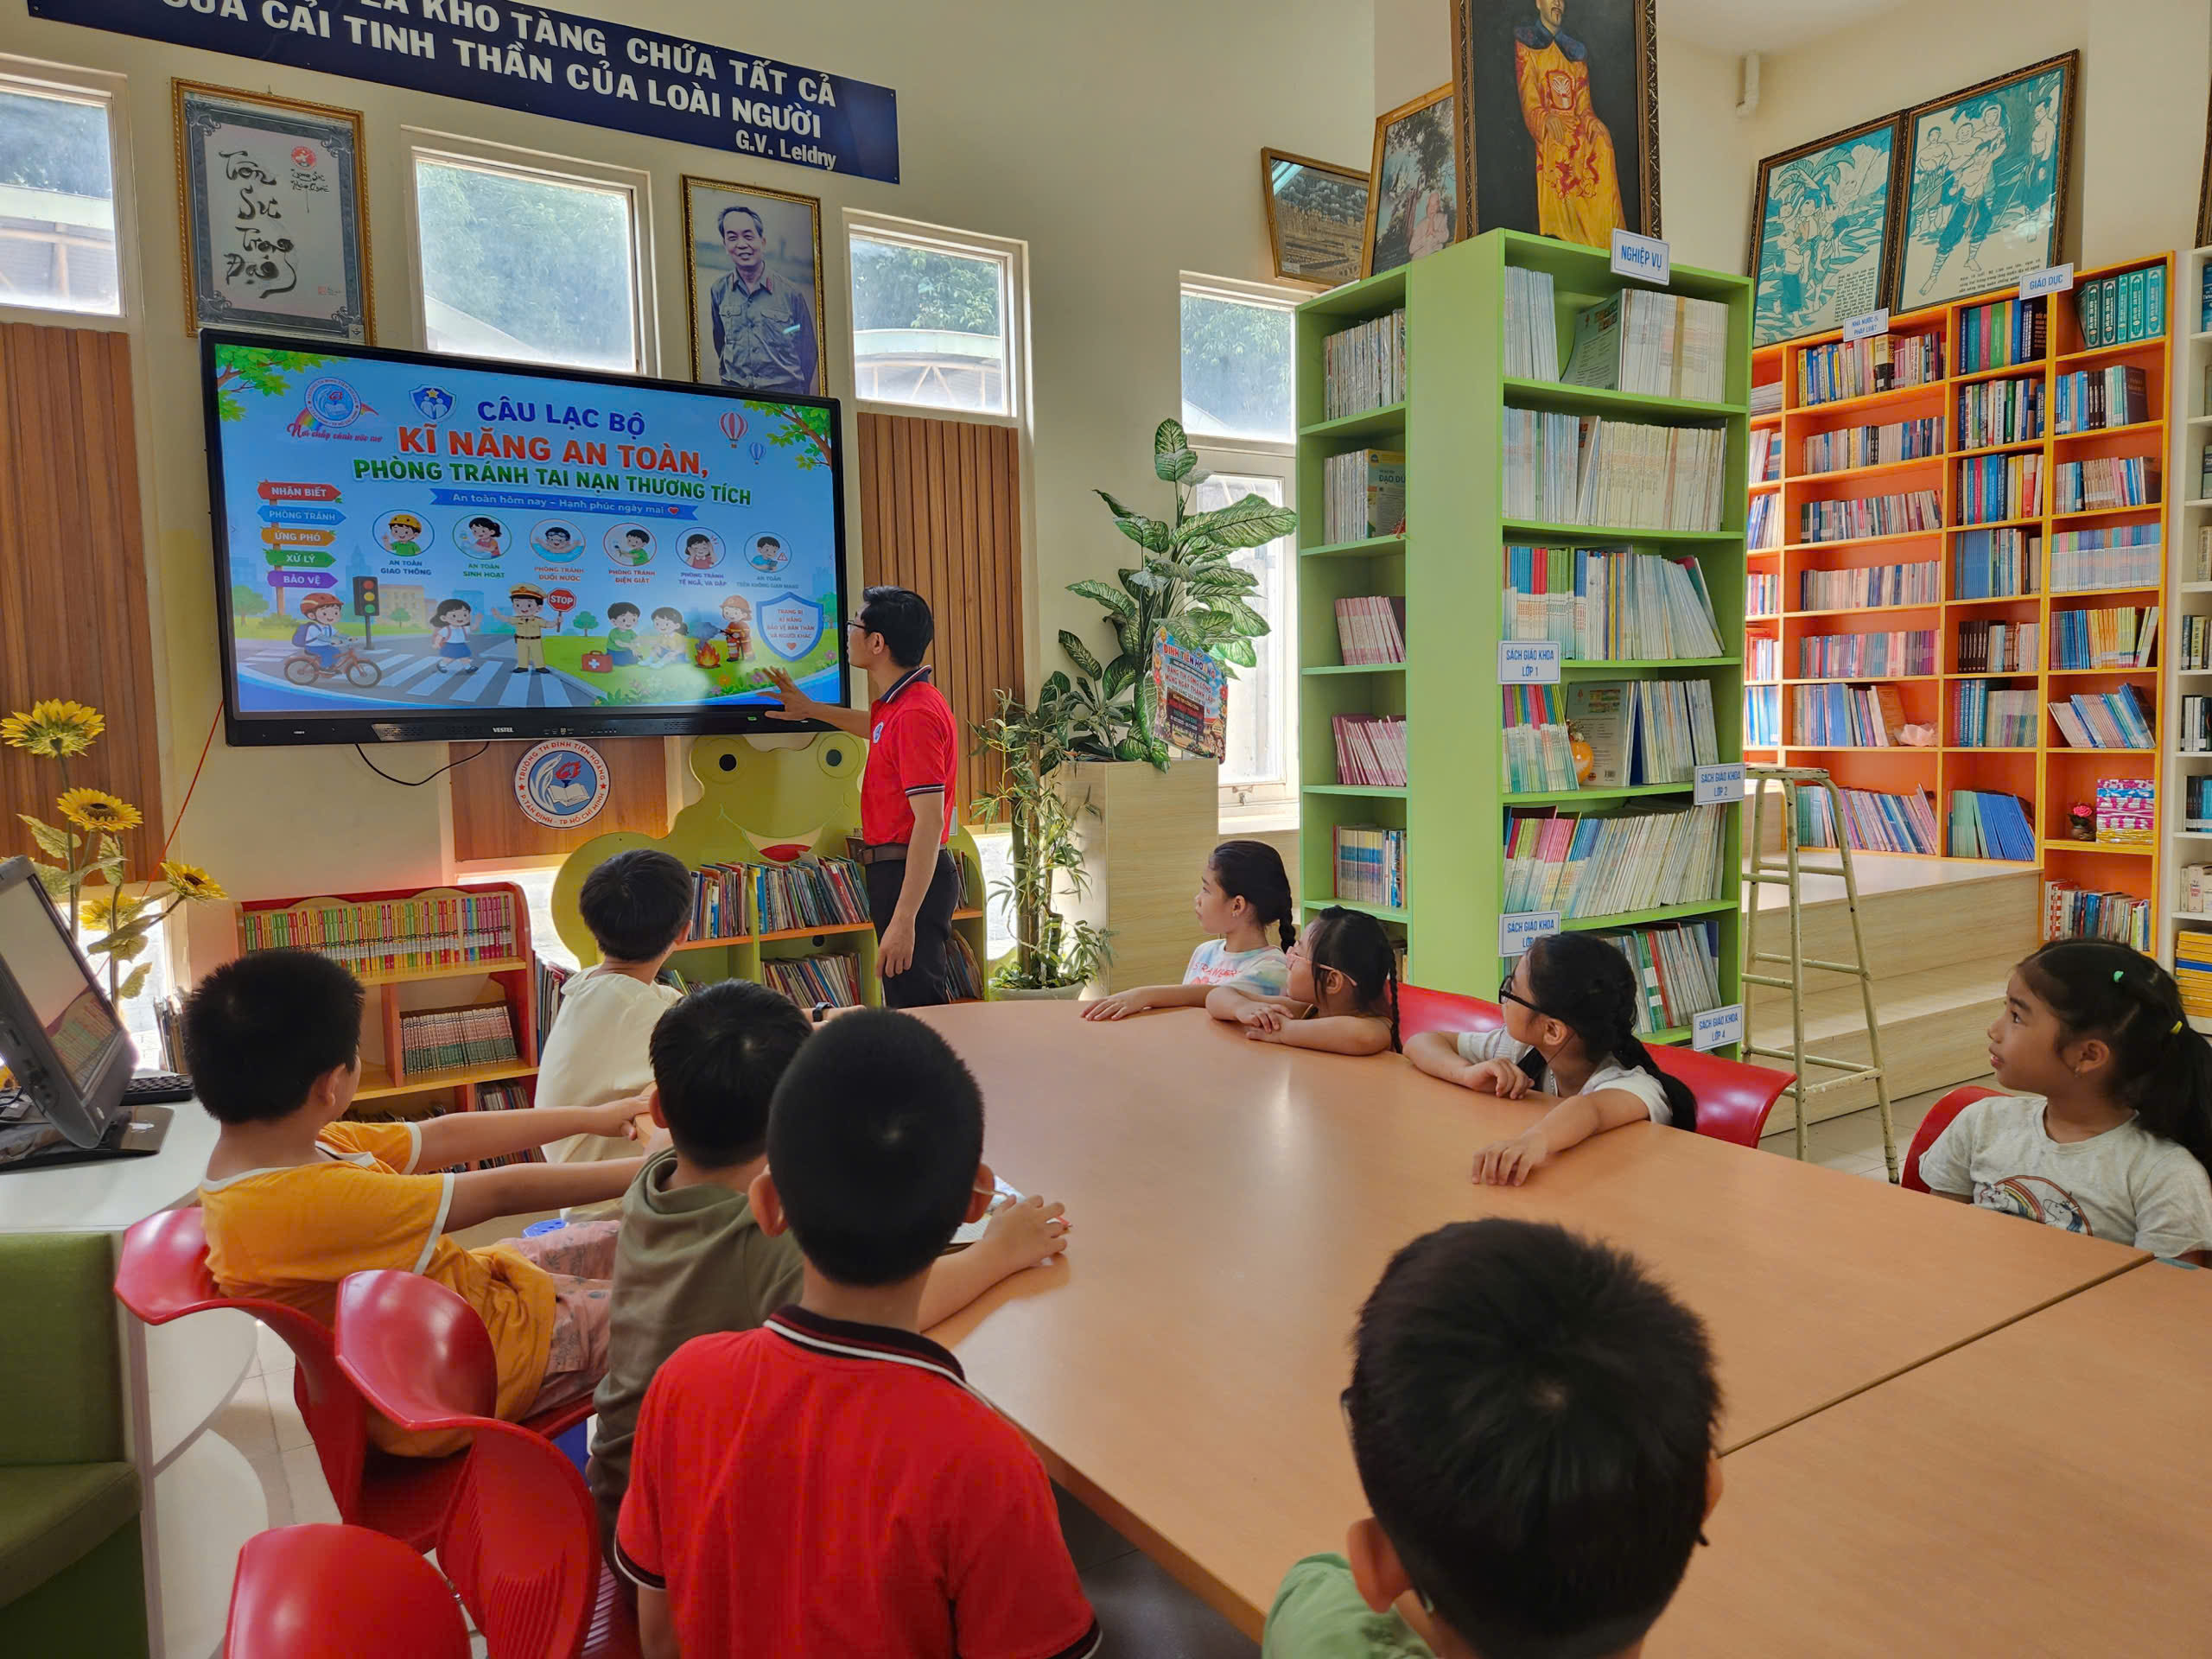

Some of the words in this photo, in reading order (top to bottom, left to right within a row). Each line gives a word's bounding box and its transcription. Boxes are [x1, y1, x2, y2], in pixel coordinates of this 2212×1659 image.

[423, 0, 500, 32] KHO
[511, 10, 607, 56] TÀNG
[626, 37, 716, 80] CHỨA
[729, 59, 787, 95] TẤT
[798, 73, 836, 107] CẢ
[262, 0, 331, 38] CẢI
[343, 15, 435, 60] TINH
[452, 38, 553, 84] THẦN
[567, 60, 639, 101] CỦA
[648, 79, 721, 118] LOÀI
[732, 97, 821, 138] NGƯỜI
[735, 129, 773, 156] G.V.
[1622, 245, 1649, 268] NGHIỆP
[1651, 251, 1662, 271] VỤ
[2030, 276, 2046, 290] GIÁO
[477, 397, 535, 422] CÂU
[546, 403, 598, 431] LẠC
[609, 408, 645, 439] BỘ
[399, 424, 437, 454] KĨ
[448, 428, 550, 461] NĂNG
[562, 440, 607, 466] AN
[617, 442, 709, 476] TOÀN,
[271, 486, 302, 498] NHẬN
[304, 486, 327, 498] BIẾT
[353, 456, 442, 480] PHÒNG
[448, 459, 529, 484] TRÁNH
[535, 467, 569, 487] TAI
[575, 473, 620, 494] NẠN
[626, 475, 705, 499] THƯƠNG
[710, 482, 752, 505] TÍCH
[269, 509, 302, 519] PHÒNG
[453, 493, 468, 503] An
[471, 494, 498, 504] toàn
[499, 495, 524, 505] hôm
[527, 499, 547, 508] nay
[559, 499, 587, 510] Hạnh
[590, 500, 615, 512] phúc
[618, 503, 643, 515] ngày
[645, 505, 664, 514] mai
[300, 531, 321, 542] PHÓ
[549, 595, 574, 605] STOP
[1506, 648, 1522, 660] SÁCH
[1523, 648, 1536, 660] GIÁO
[1538, 650, 1554, 660] KHOA
[1522, 664, 1533, 677] LỚP
[538, 745, 550, 753] TH
[574, 743, 590, 755] TIÊN
[590, 753, 606, 780] HOÀNG
[535, 810, 553, 823] ĐỊNH
[569, 815, 581, 824] HỒ
[592, 792, 605, 811] MINH
[1507, 920, 1522, 933] SÁCH
[1524, 918, 1537, 931] GIÁO
[1539, 918, 1554, 931] KHOA
